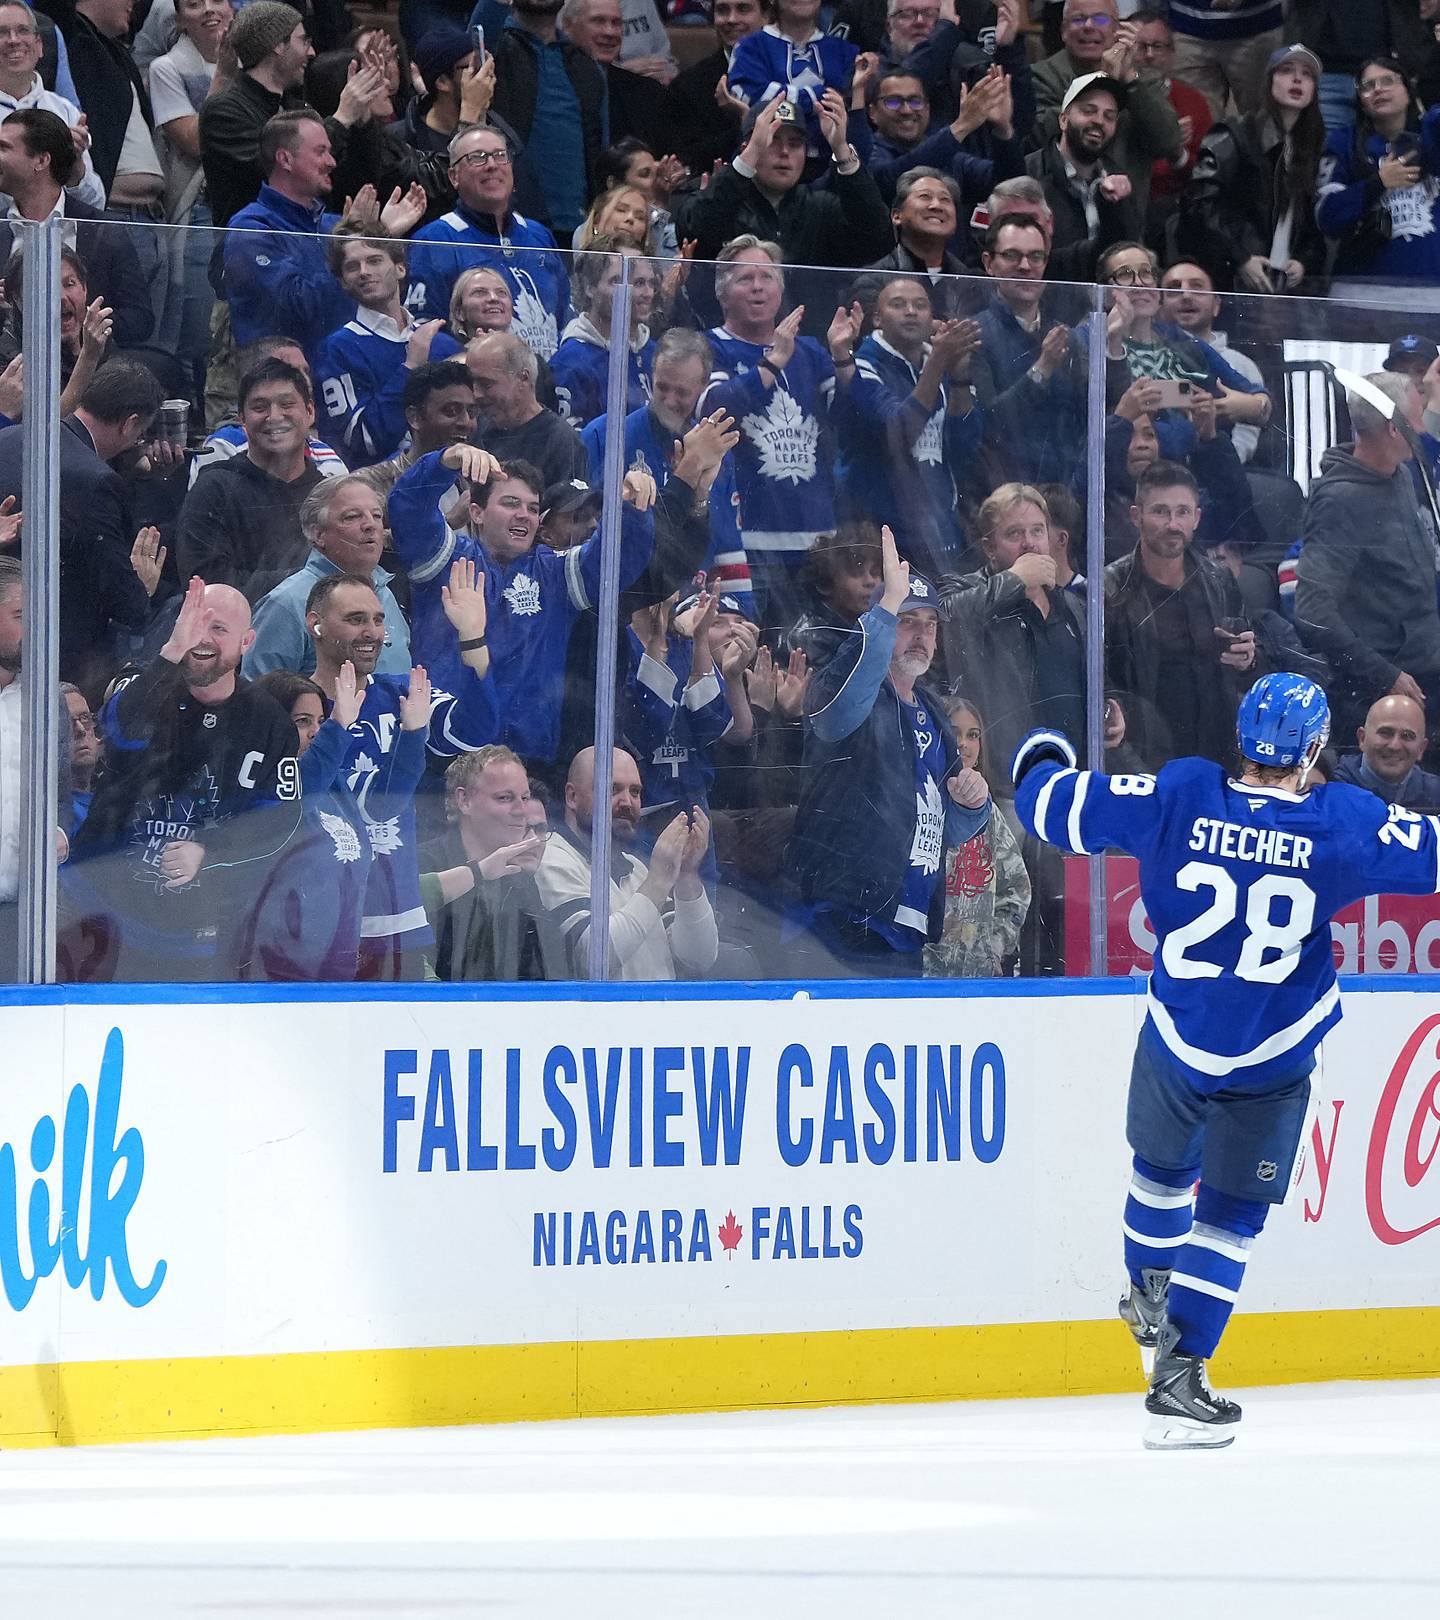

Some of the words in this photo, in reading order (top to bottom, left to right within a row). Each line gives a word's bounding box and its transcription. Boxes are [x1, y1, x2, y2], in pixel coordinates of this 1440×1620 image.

[322, 372, 359, 418] 91
[762, 426, 814, 446] TORONTO
[773, 441, 808, 454] MAPLE
[774, 452, 810, 465] LEAFS
[511, 589, 538, 600] TORONTO
[517, 601, 536, 609] LEAFS
[661, 747, 686, 758] LEAFS
[1256, 740, 1275, 755] 28
[238, 751, 264, 789] C
[1188, 817, 1314, 870] STECHER
[1161, 860, 1317, 985] 28
[382, 1044, 751, 1173] FALLSVIEW
[775, 1042, 1007, 1167] CASINO
[532, 1208, 713, 1266] NIAGARA
[751, 1203, 865, 1261] FALLS
